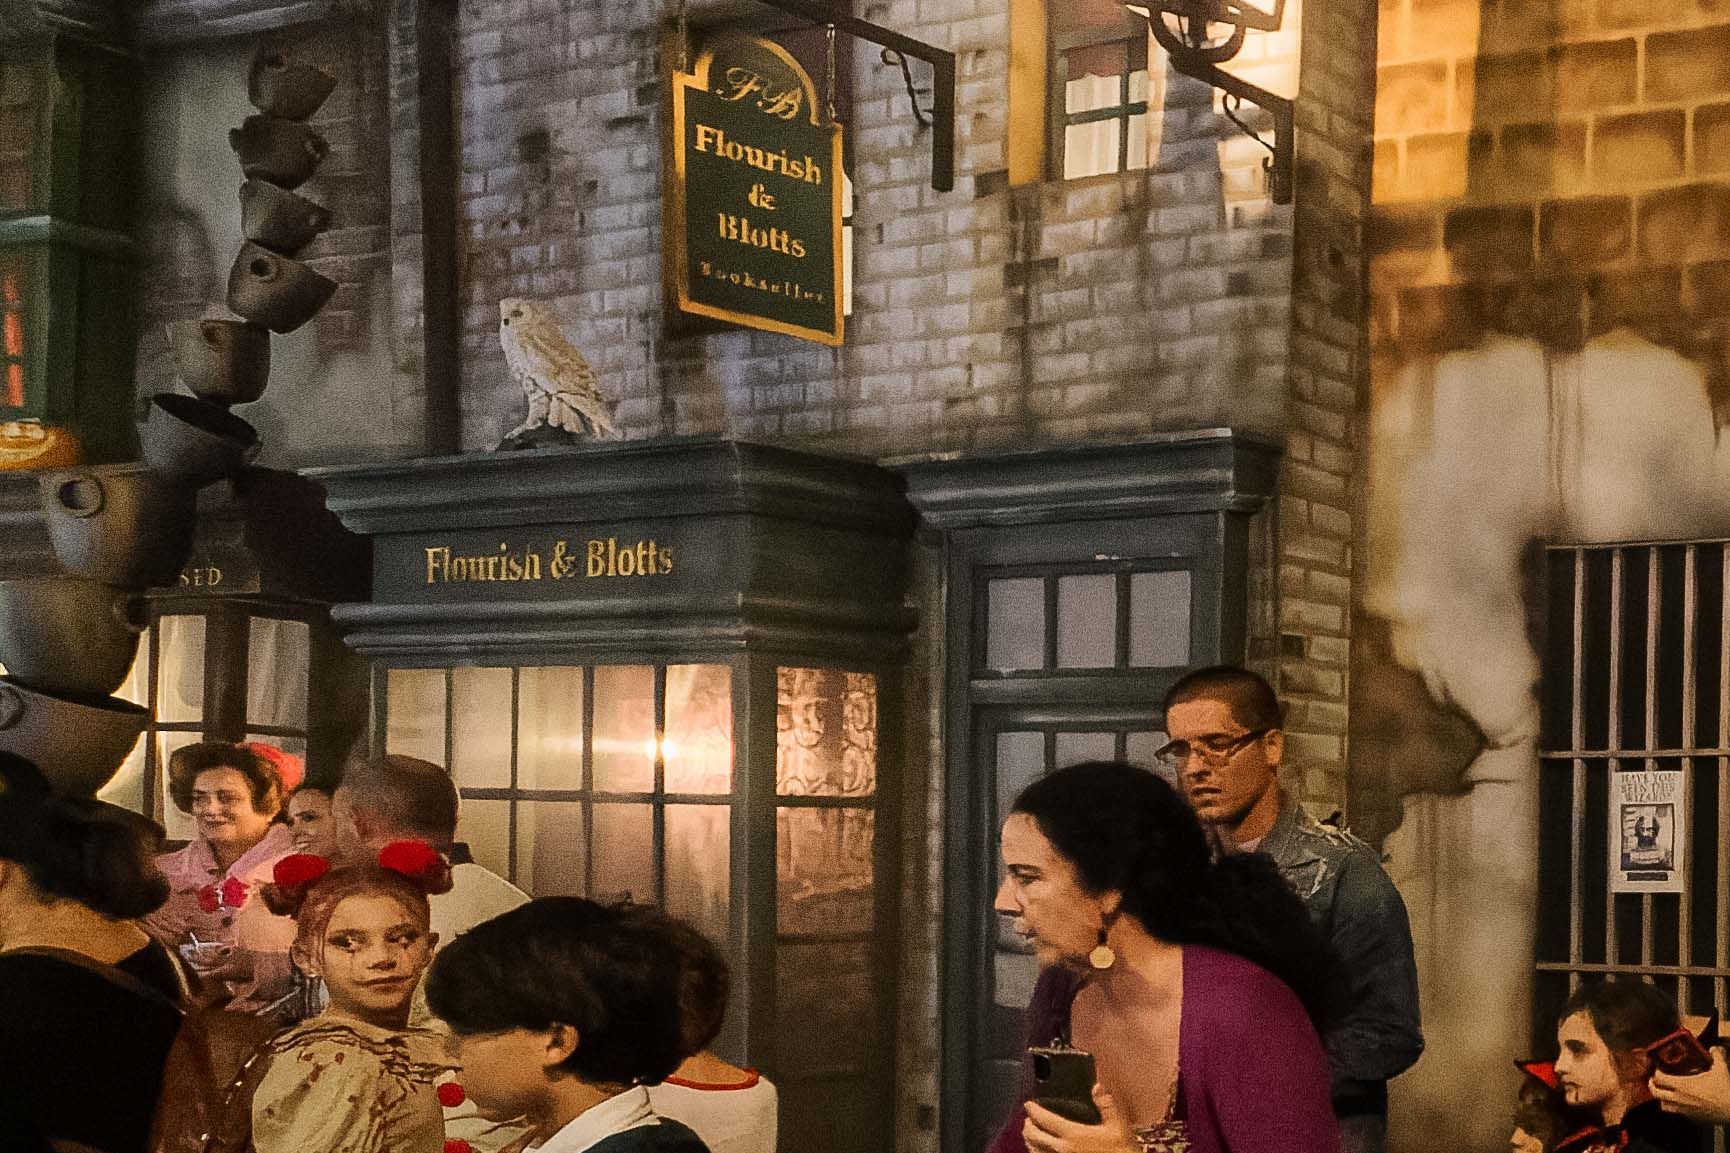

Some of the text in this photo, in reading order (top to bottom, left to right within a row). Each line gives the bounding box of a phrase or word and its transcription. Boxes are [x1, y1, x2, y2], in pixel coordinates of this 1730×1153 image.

[694, 124, 822, 185] Flourish
[748, 183, 776, 210] &
[719, 213, 806, 258] Blotts
[424, 537, 673, 584] Flourish & Blotts
